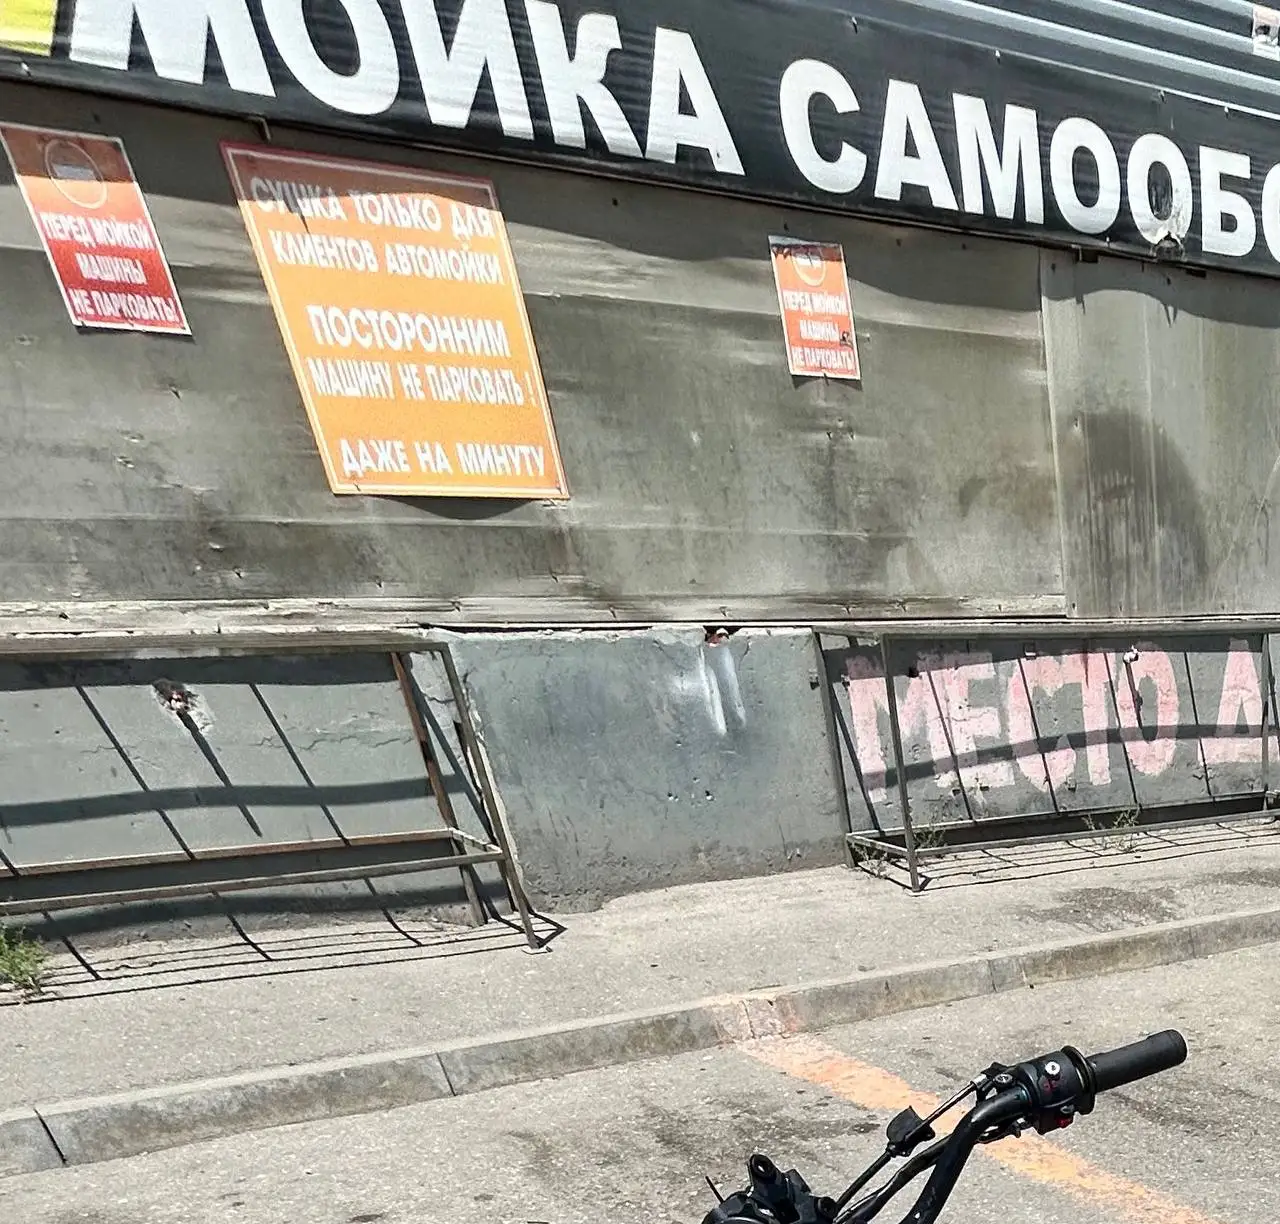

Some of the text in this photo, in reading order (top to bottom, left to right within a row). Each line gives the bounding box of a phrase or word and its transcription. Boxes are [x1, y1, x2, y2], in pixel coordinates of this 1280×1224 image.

[249, 177, 495, 240] СУШКА ТОЛЬКО ДЛЯ
[40, 212, 155, 249] ПЕРЕД МОЙКОЙ
[75, 252, 148, 285] МАШИНЫ
[268, 229, 505, 285] КЛИЕНТОВ АВТОМОЙКИ
[68, 288, 96, 315] НЕ
[306, 304, 511, 357] ПОСТОРОННИМ
[308, 357, 396, 399] МАШИНУ
[398, 362, 426, 400] НЕ
[339, 439, 546, 478] ДАЖЕ НА МИНУТУ
[845, 642, 1180, 802] МЕСТО
